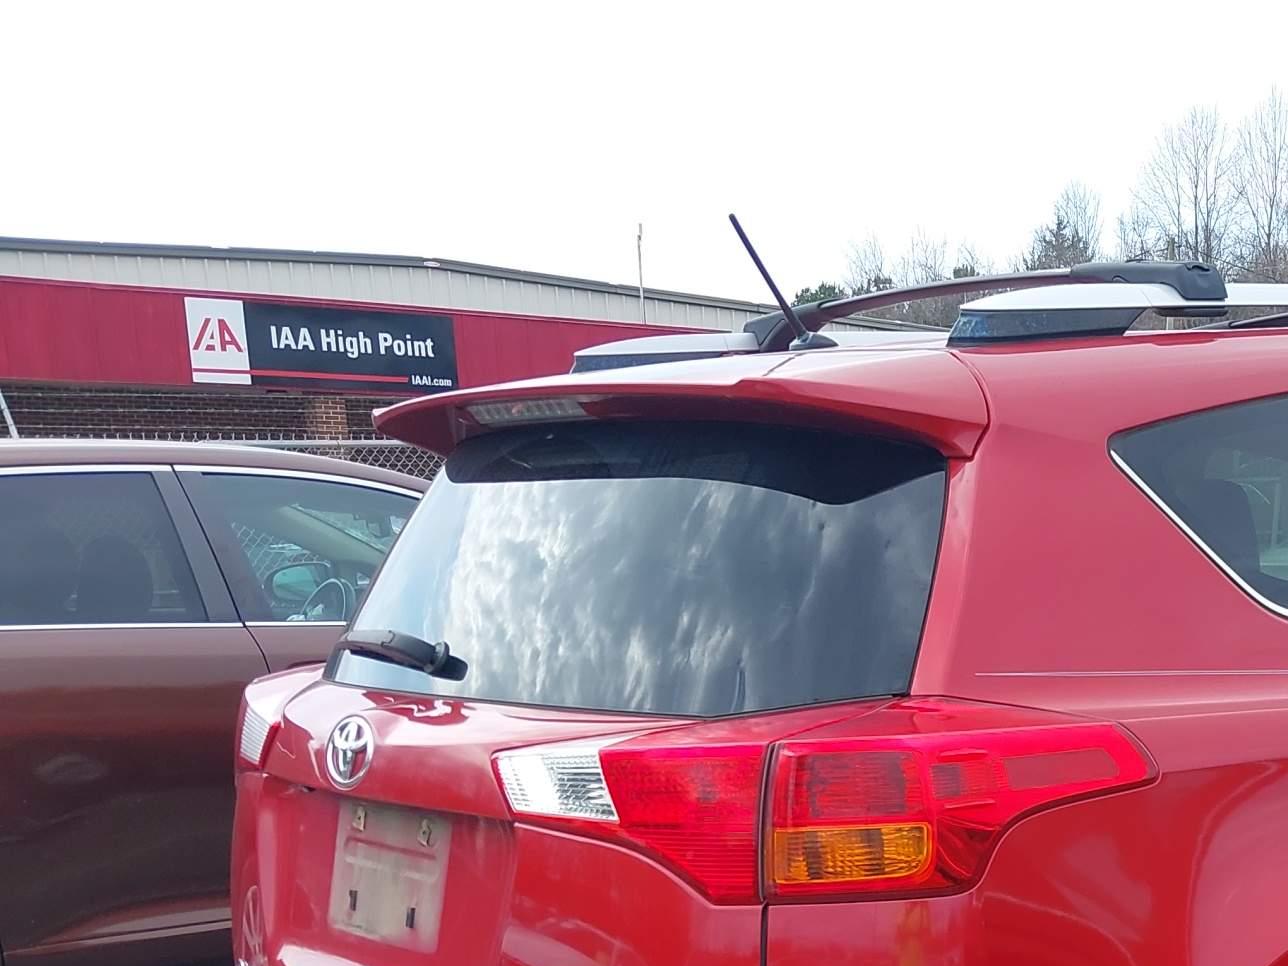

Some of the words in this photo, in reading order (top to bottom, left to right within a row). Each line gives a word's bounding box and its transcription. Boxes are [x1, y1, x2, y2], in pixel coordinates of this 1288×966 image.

[270, 324, 316, 351] IAA
[320, 328, 373, 359] High
[378, 331, 435, 358] Point
[411, 374, 453, 387] IAAI.com
